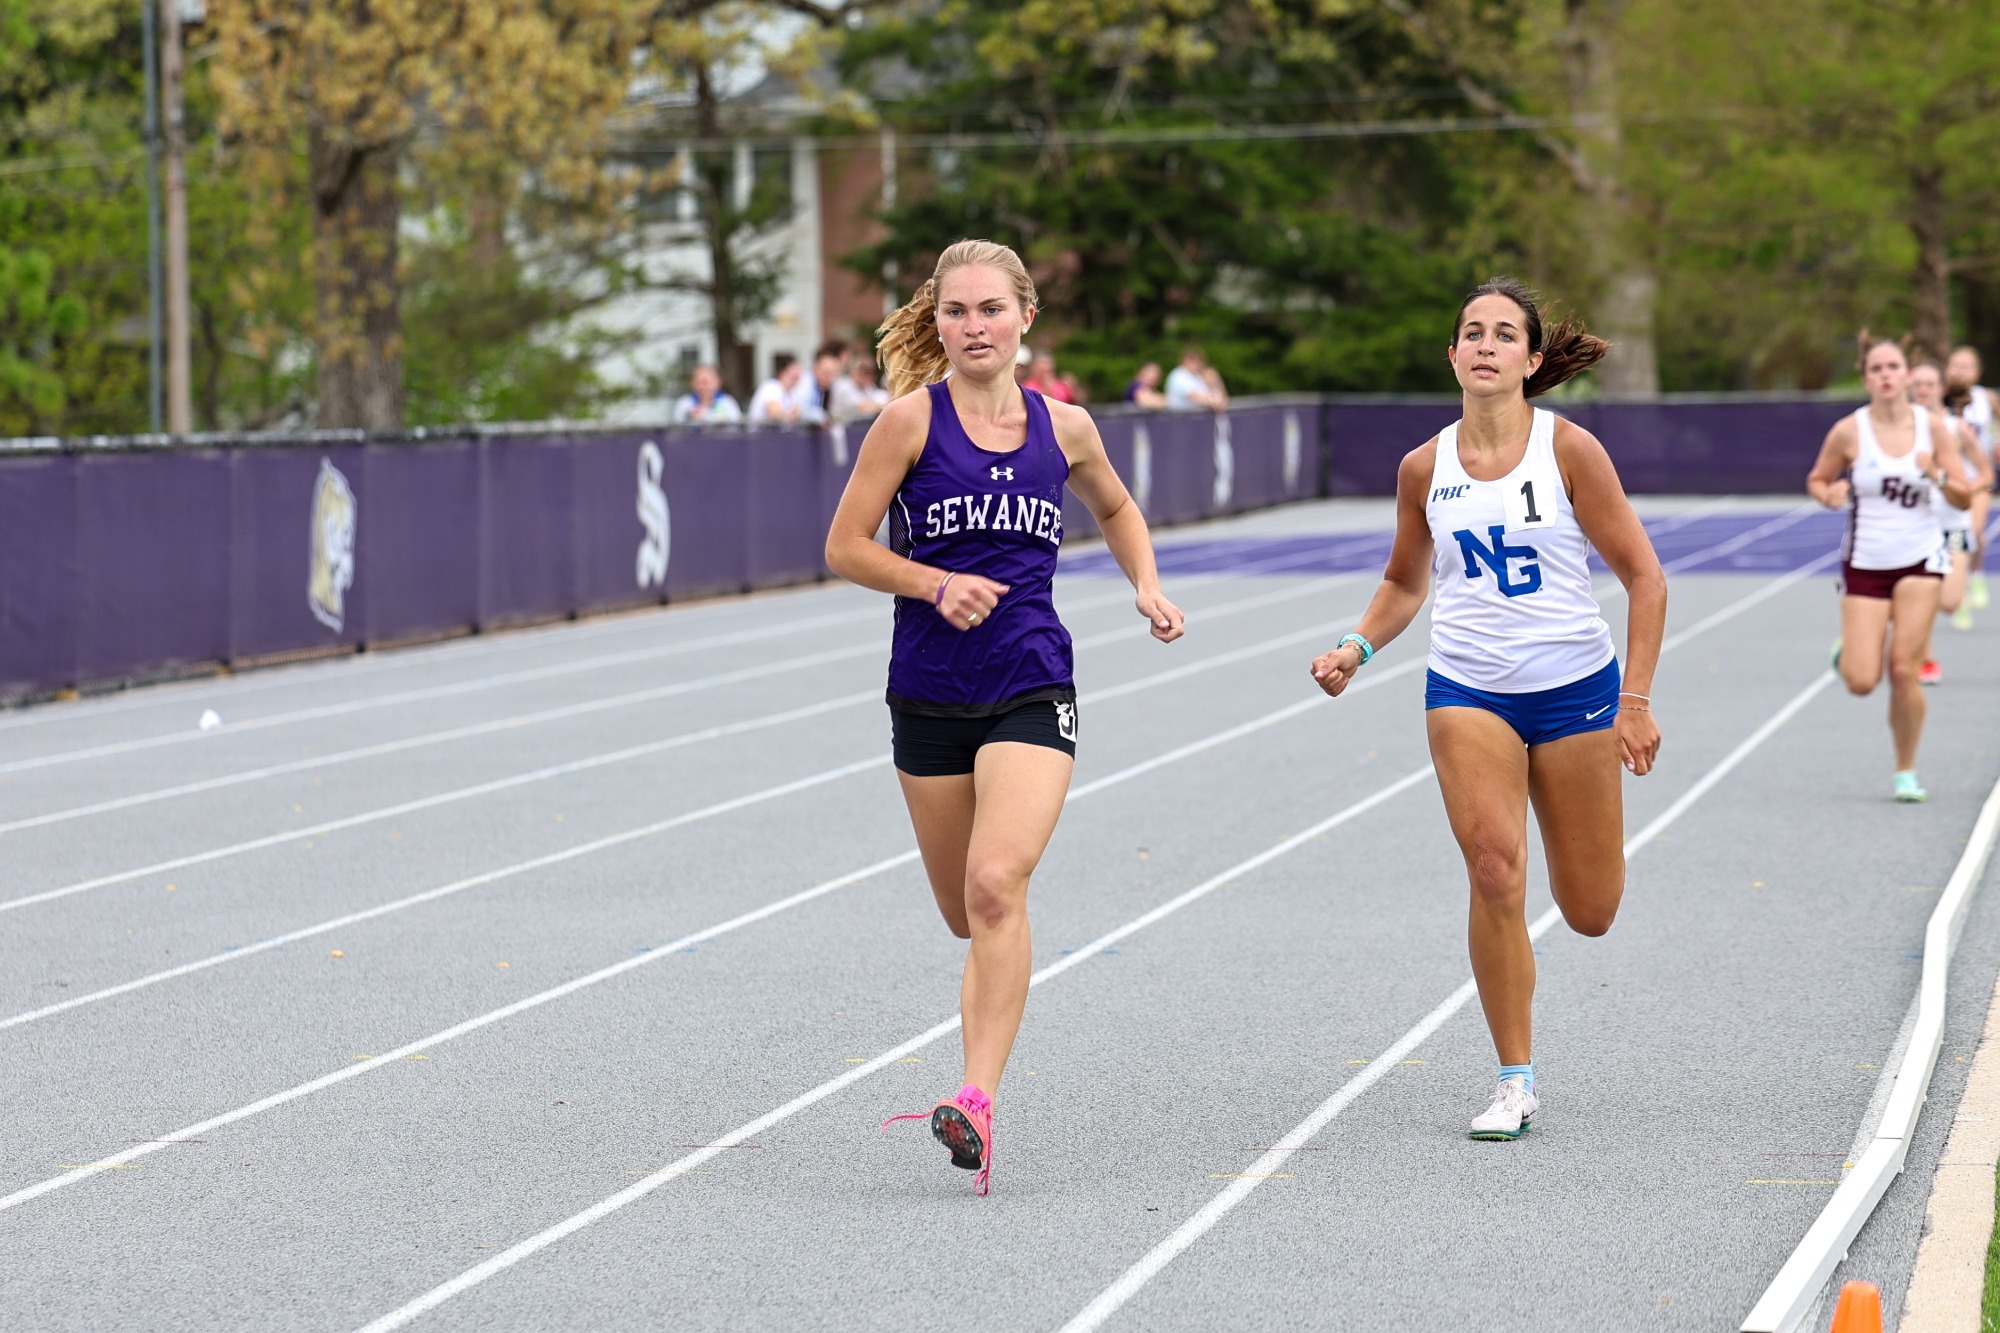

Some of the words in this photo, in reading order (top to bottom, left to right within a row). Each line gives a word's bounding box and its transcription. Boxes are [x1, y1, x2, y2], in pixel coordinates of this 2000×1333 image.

[1432, 484, 1471, 502] PBC
[1520, 480, 1542, 523] 1
[926, 494, 1061, 546] SEWANEE
[1452, 525, 1543, 598] NG
